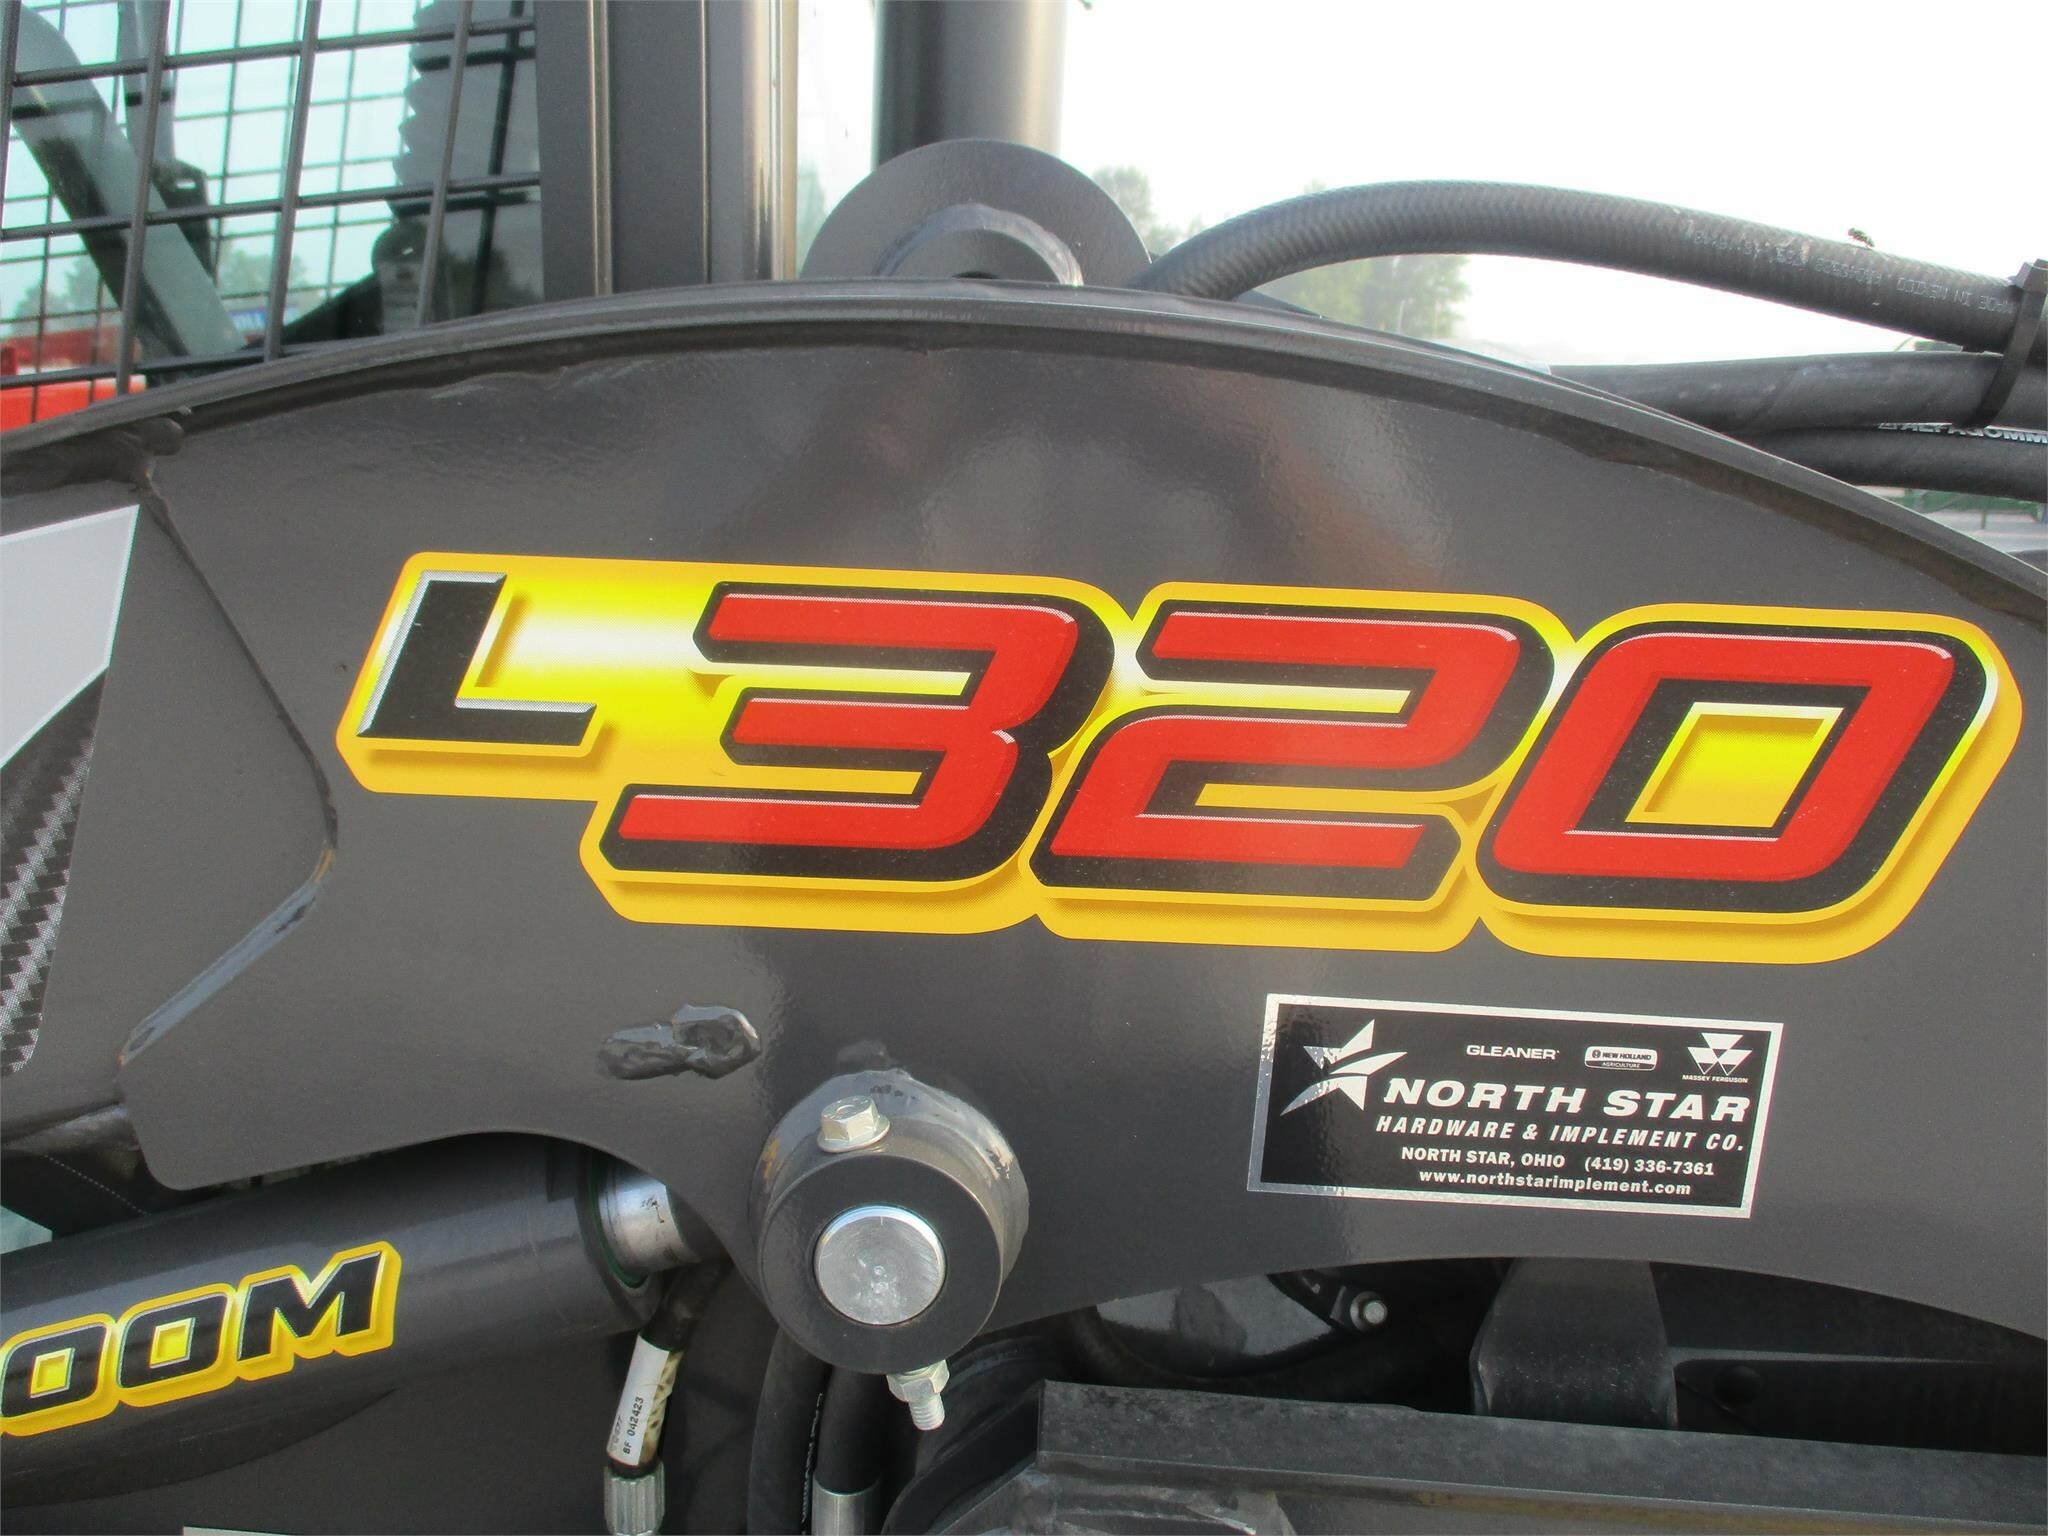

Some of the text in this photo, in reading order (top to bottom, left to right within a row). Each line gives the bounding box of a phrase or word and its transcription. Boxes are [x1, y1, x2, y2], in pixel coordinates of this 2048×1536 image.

[350, 562, 1998, 918] L320
[1466, 1044, 1556, 1060] GLEANER
[1602, 1051, 1652, 1061] NEW HOLLAND
[1602, 1061, 1641, 1069] AGRICULTURE
[1682, 1074, 1749, 1084] MASSEY FERGUSON
[1383, 1077, 1751, 1122] NORTH STAR
[1375, 1115, 1745, 1151] HARDWARE & IMPLEMENT CO.
[1401, 1146, 1715, 1176] NORTH STAR, OHIO (419) 336-7361
[1419, 1171, 1691, 1196] www.northstarimplement.com
[626, 1396, 644, 1437] 042423
